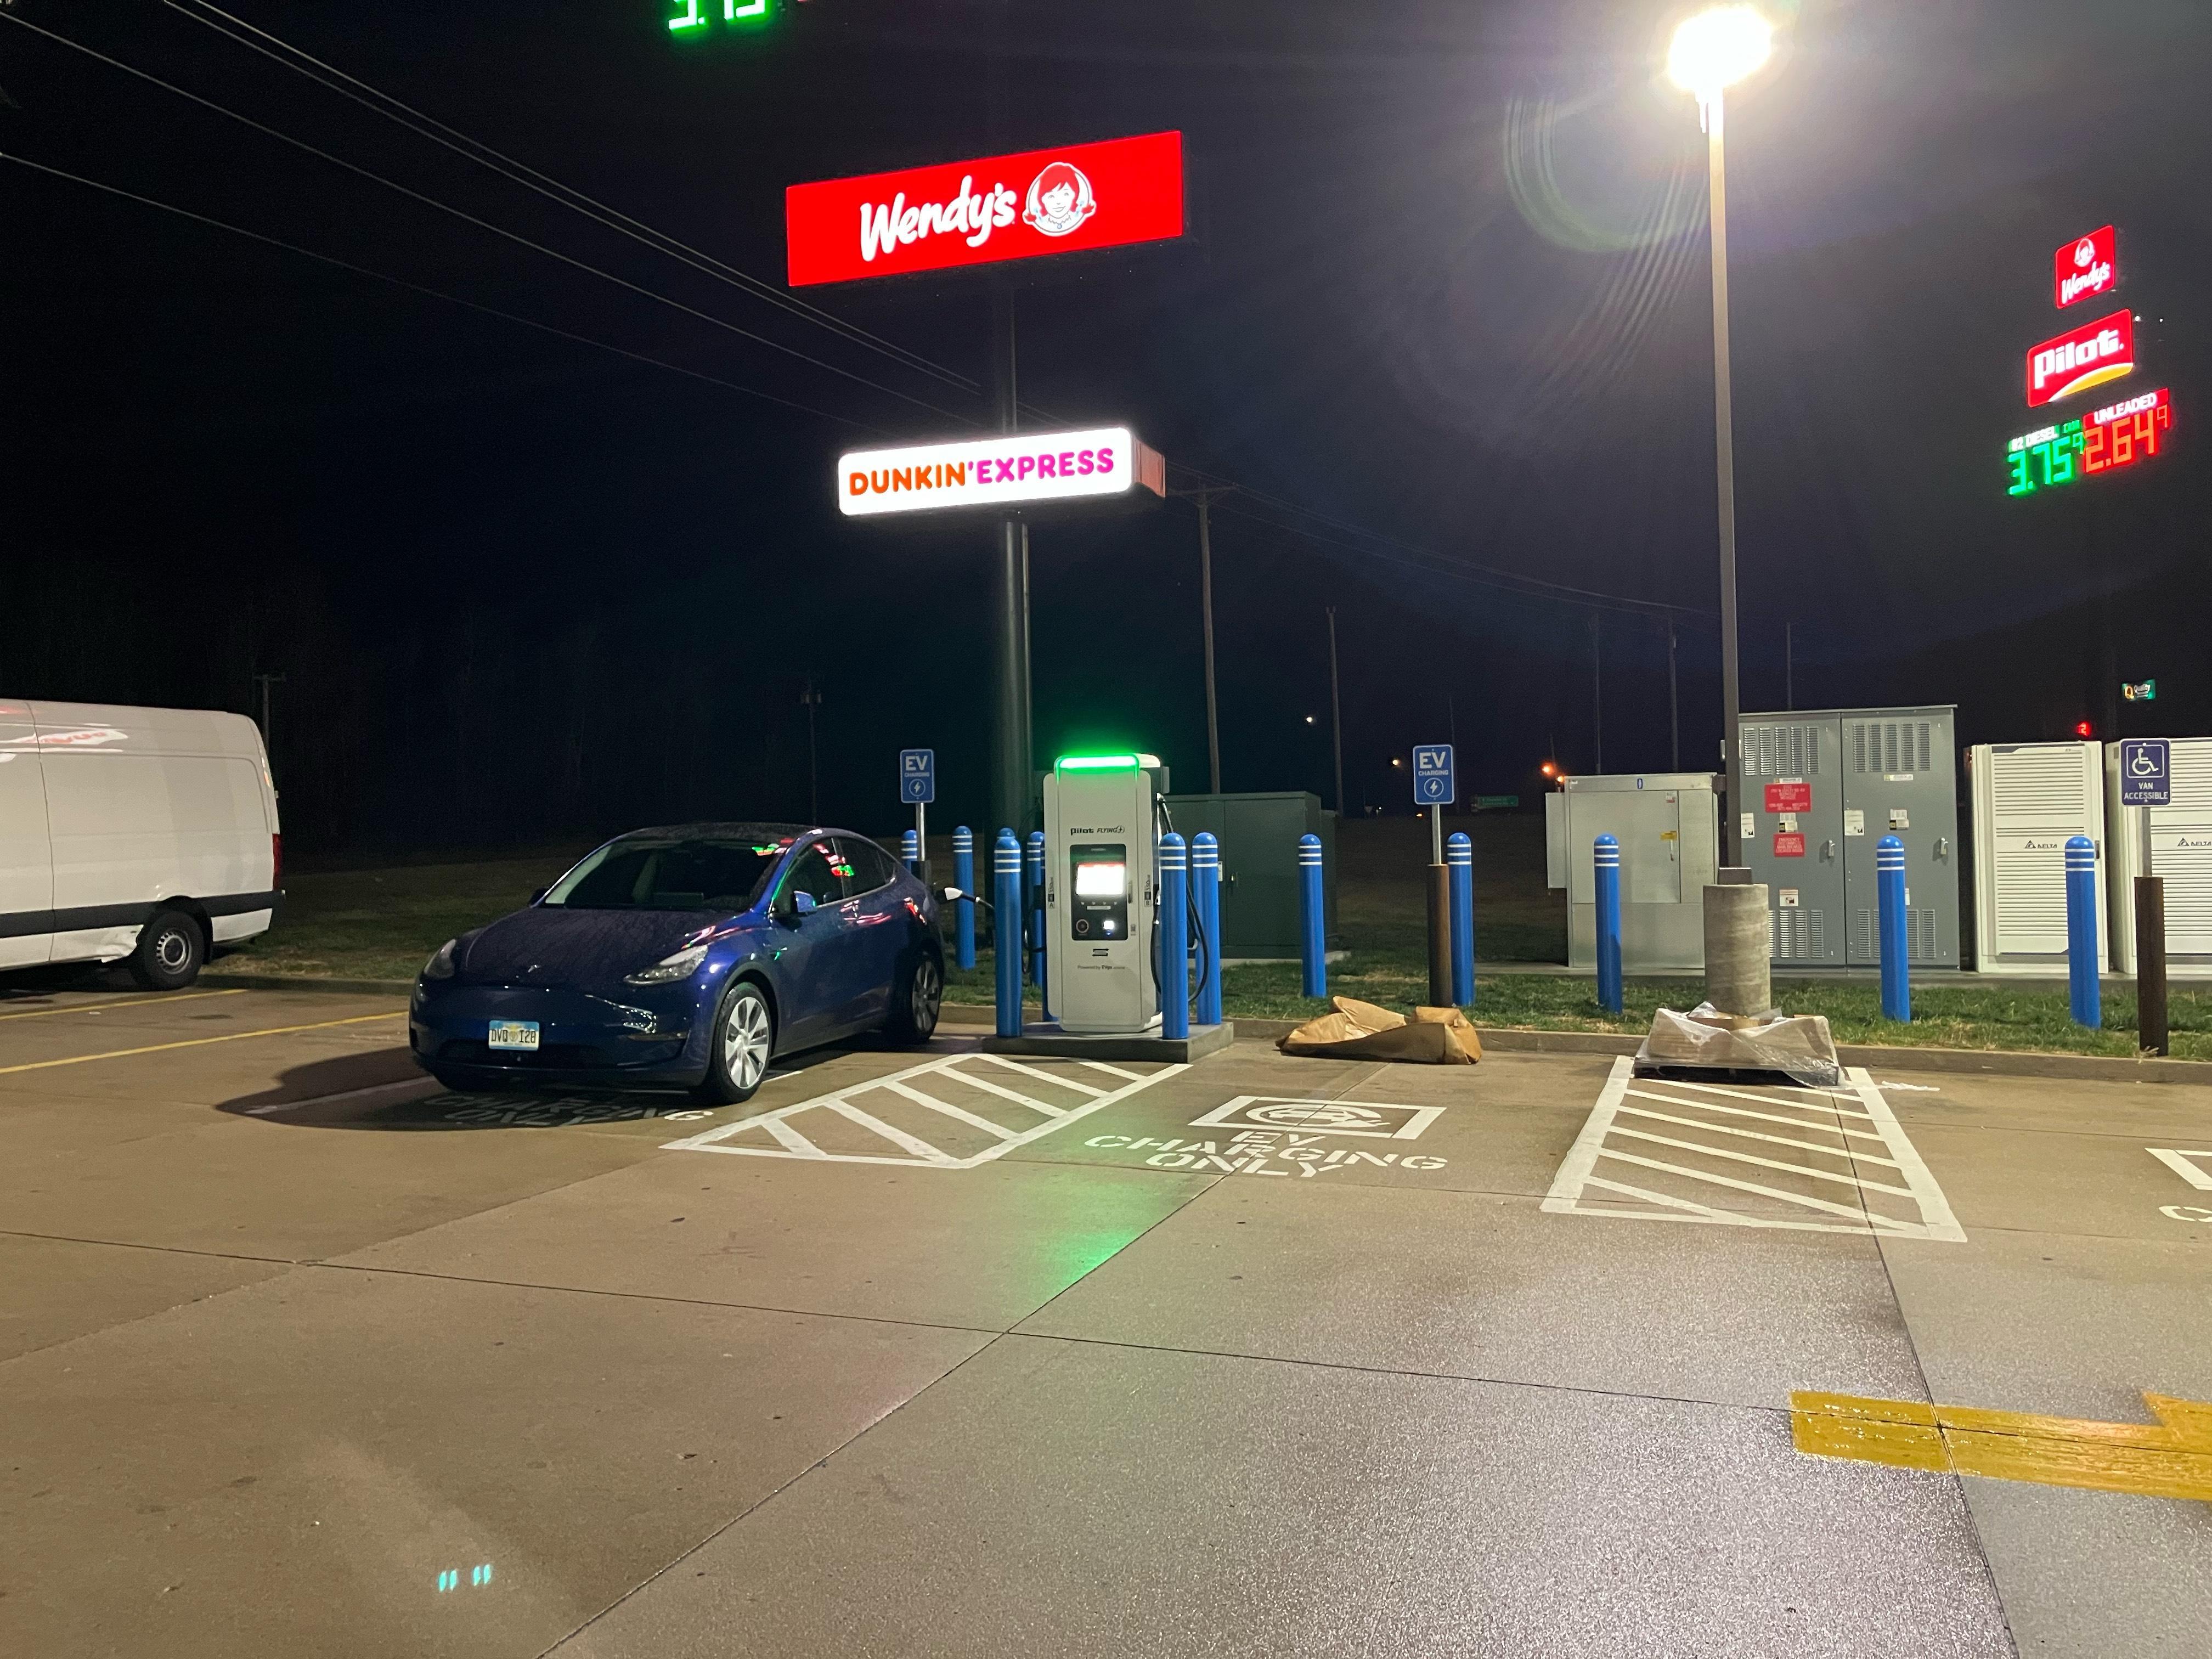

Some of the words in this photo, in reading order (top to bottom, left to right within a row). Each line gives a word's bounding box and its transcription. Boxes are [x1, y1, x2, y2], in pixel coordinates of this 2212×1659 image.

[860, 175, 1017, 261] Wendy's
[2061, 261, 2111, 304] Wendy's
[2094, 393, 2157, 425] UNLEADED
[905, 755, 928, 771] EV
[1419, 752, 1446, 769] EV
[2124, 792, 2169, 800] ACCESSIBLE
[1230, 1130, 1327, 1146] EV
[1084, 1135, 1449, 1169] CHARGING
[1145, 1153, 1345, 1178] ONLY
